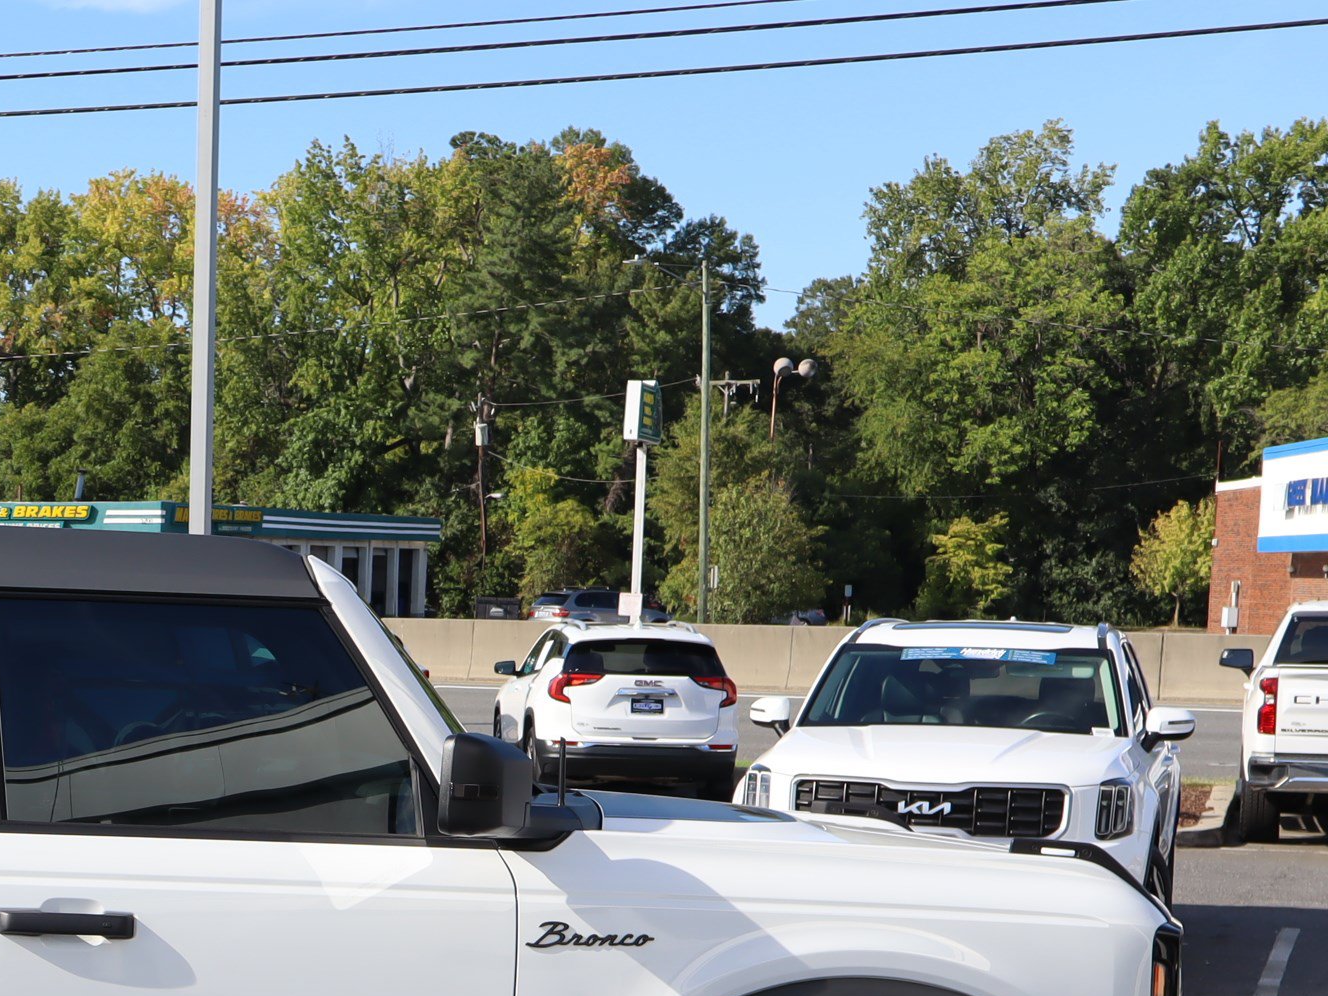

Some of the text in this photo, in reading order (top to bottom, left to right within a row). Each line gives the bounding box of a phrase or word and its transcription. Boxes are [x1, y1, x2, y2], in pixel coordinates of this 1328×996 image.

[13, 505, 90, 518] BRAKES
[634, 679, 664, 687] GMC
[897, 800, 951, 815] KIA
[525, 921, 655, 948] Bronco
